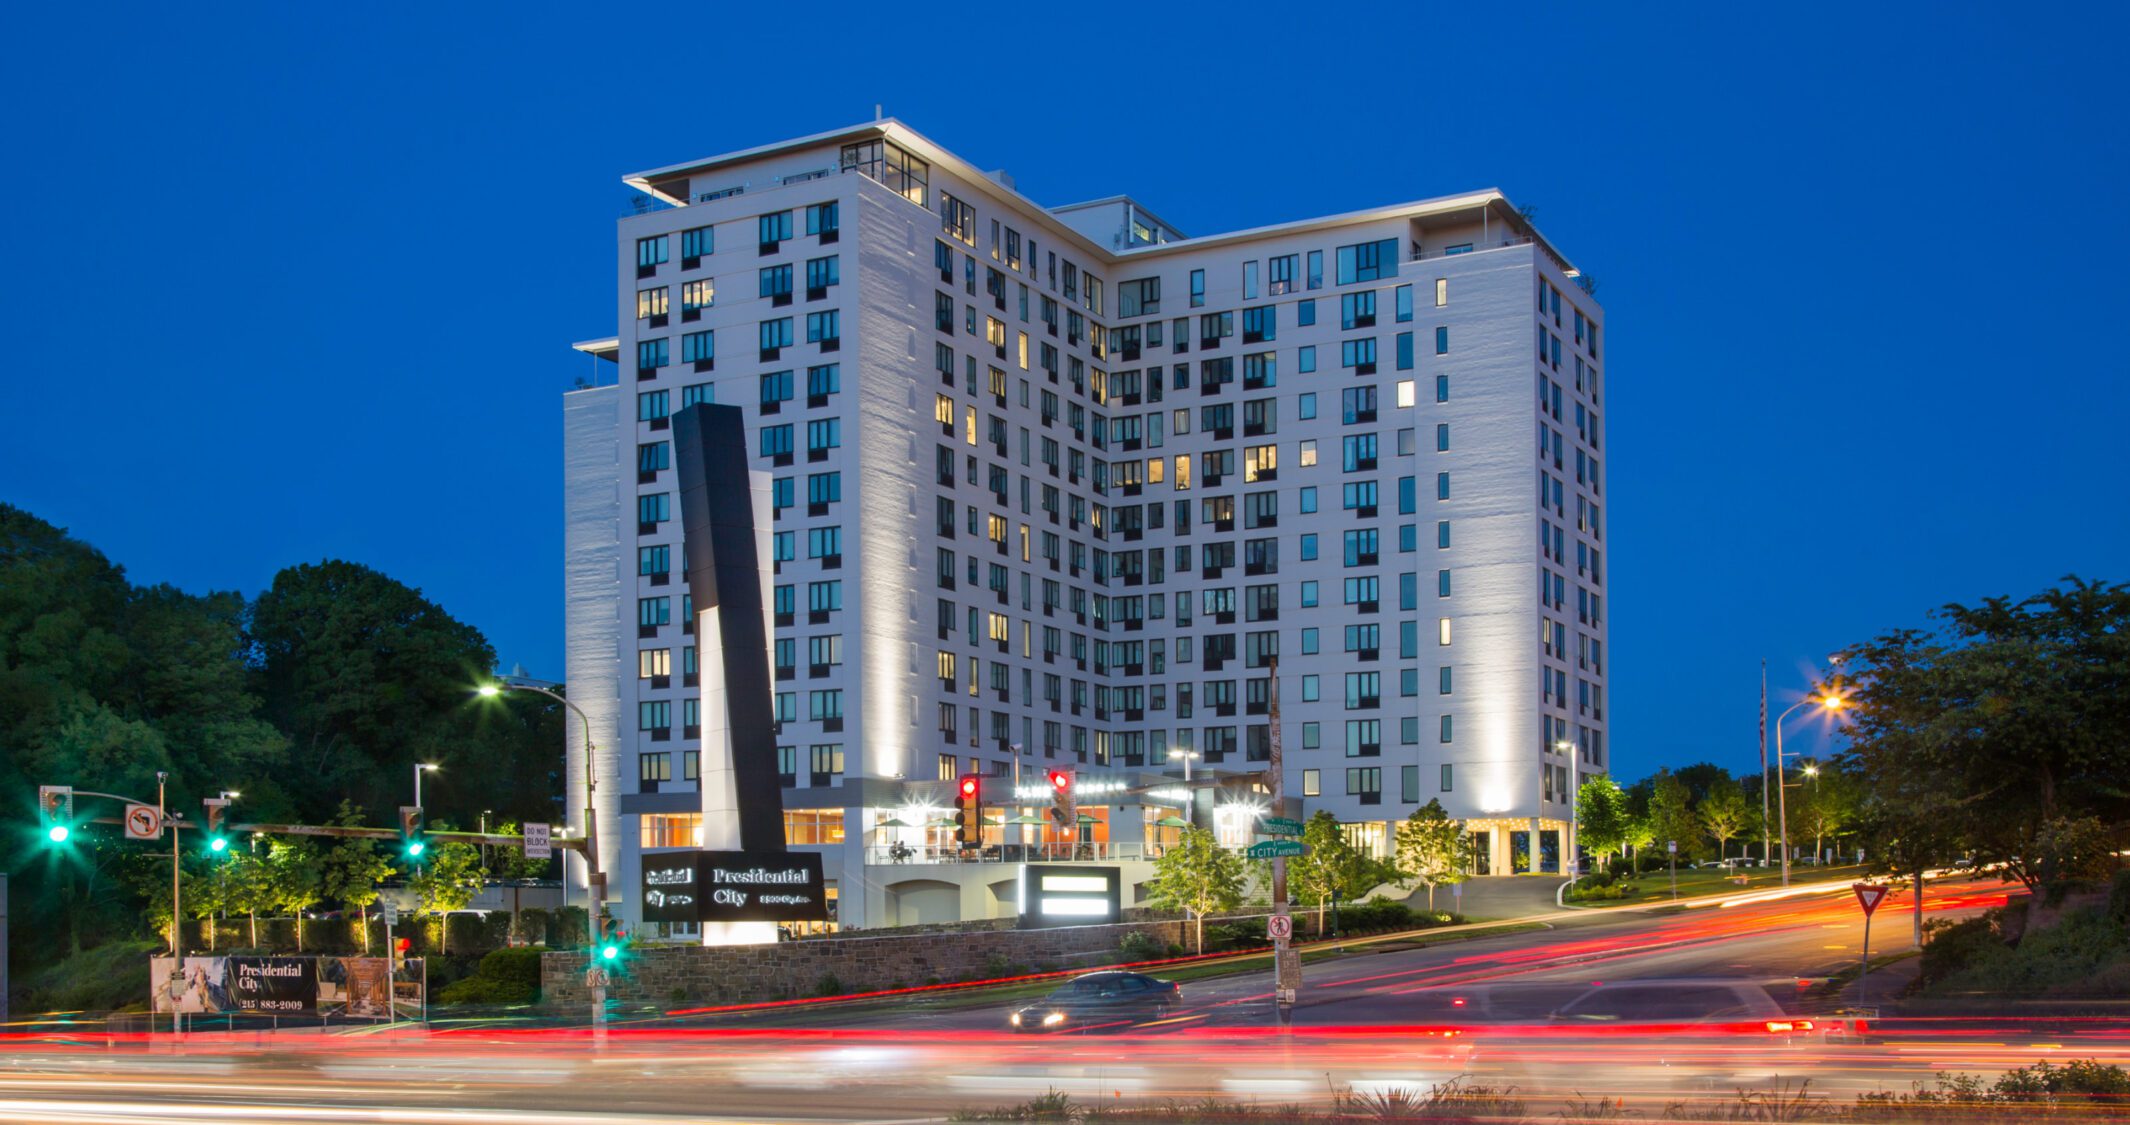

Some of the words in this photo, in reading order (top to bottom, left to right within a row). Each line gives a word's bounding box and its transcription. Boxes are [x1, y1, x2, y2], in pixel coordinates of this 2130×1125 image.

[526, 827, 535, 835] DO
[1263, 823, 1298, 835] PRESIDENTIAL
[526, 837, 548, 846] BLOCK
[1257, 847, 1277, 857] CITY
[1277, 848, 1300, 856] AVENUE
[713, 868, 809, 884] Presidential
[713, 889, 747, 907] City
[239, 963, 302, 977] Presidential
[238, 998, 259, 1010] (215)
[260, 1000, 303, 1011] 883-2009
